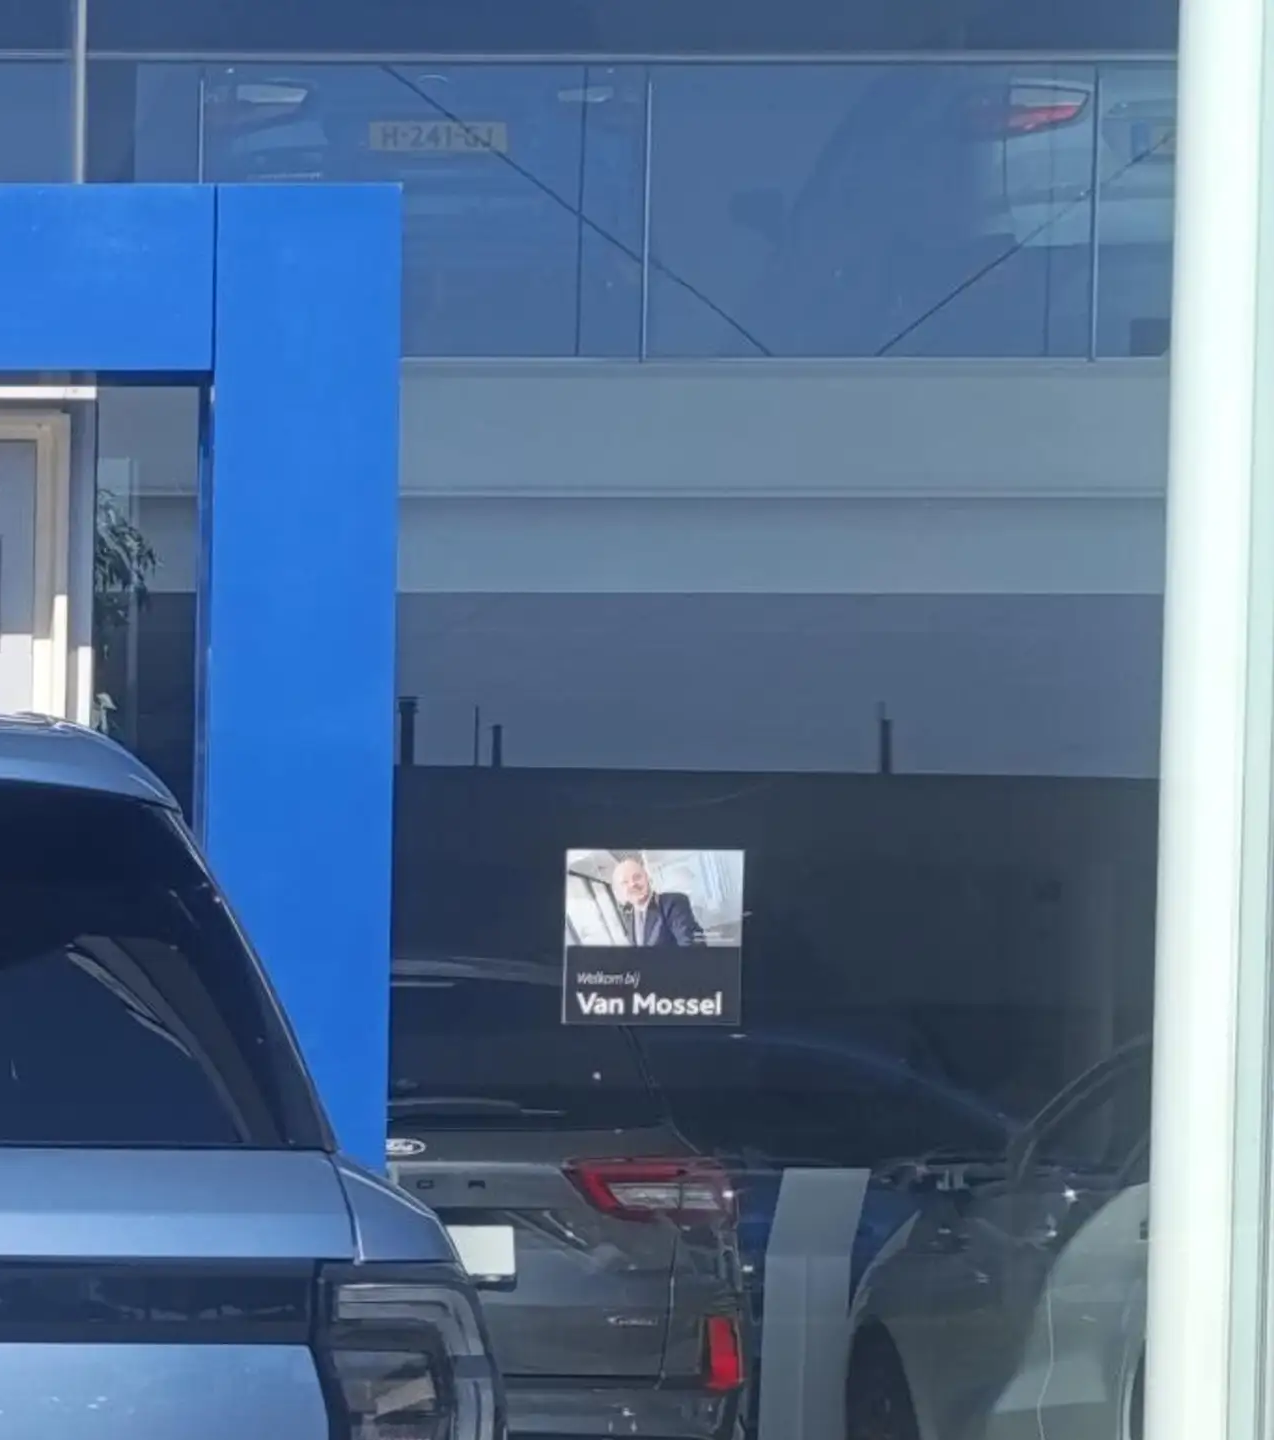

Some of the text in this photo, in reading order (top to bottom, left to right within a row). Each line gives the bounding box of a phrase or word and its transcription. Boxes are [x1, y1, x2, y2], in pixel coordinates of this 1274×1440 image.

[576, 971, 623, 986] Welkom
[576, 991, 723, 1015] Van Mossel
